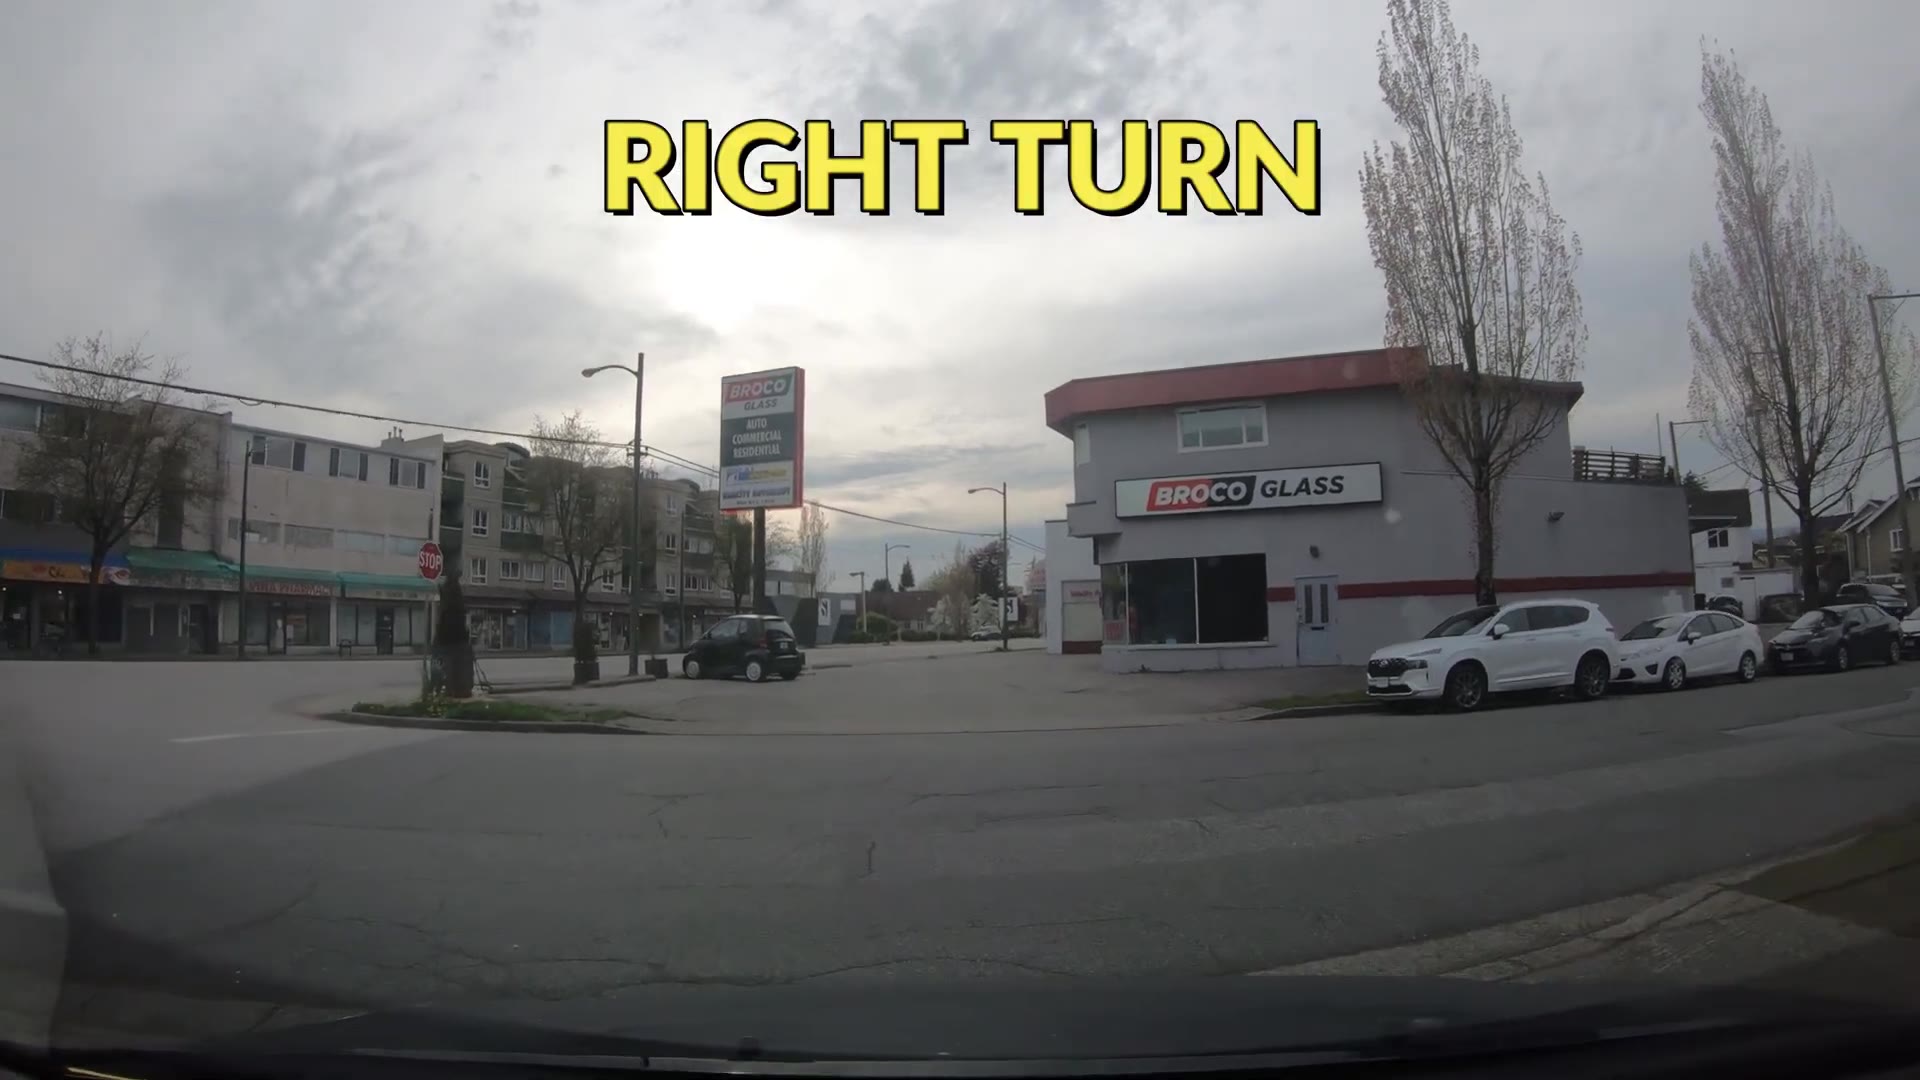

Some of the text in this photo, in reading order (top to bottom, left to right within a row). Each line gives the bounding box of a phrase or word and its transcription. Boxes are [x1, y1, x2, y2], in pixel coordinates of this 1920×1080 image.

[729, 380, 786, 399] BROCO
[744, 398, 778, 411] GLASS
[746, 417, 768, 430] AUTO
[732, 429, 782, 445] COMMERCIAL
[733, 443, 780, 458] RESIDENTIAL
[1154, 475, 1345, 506] BROCO GLASS
[420, 551, 441, 570] STOP
